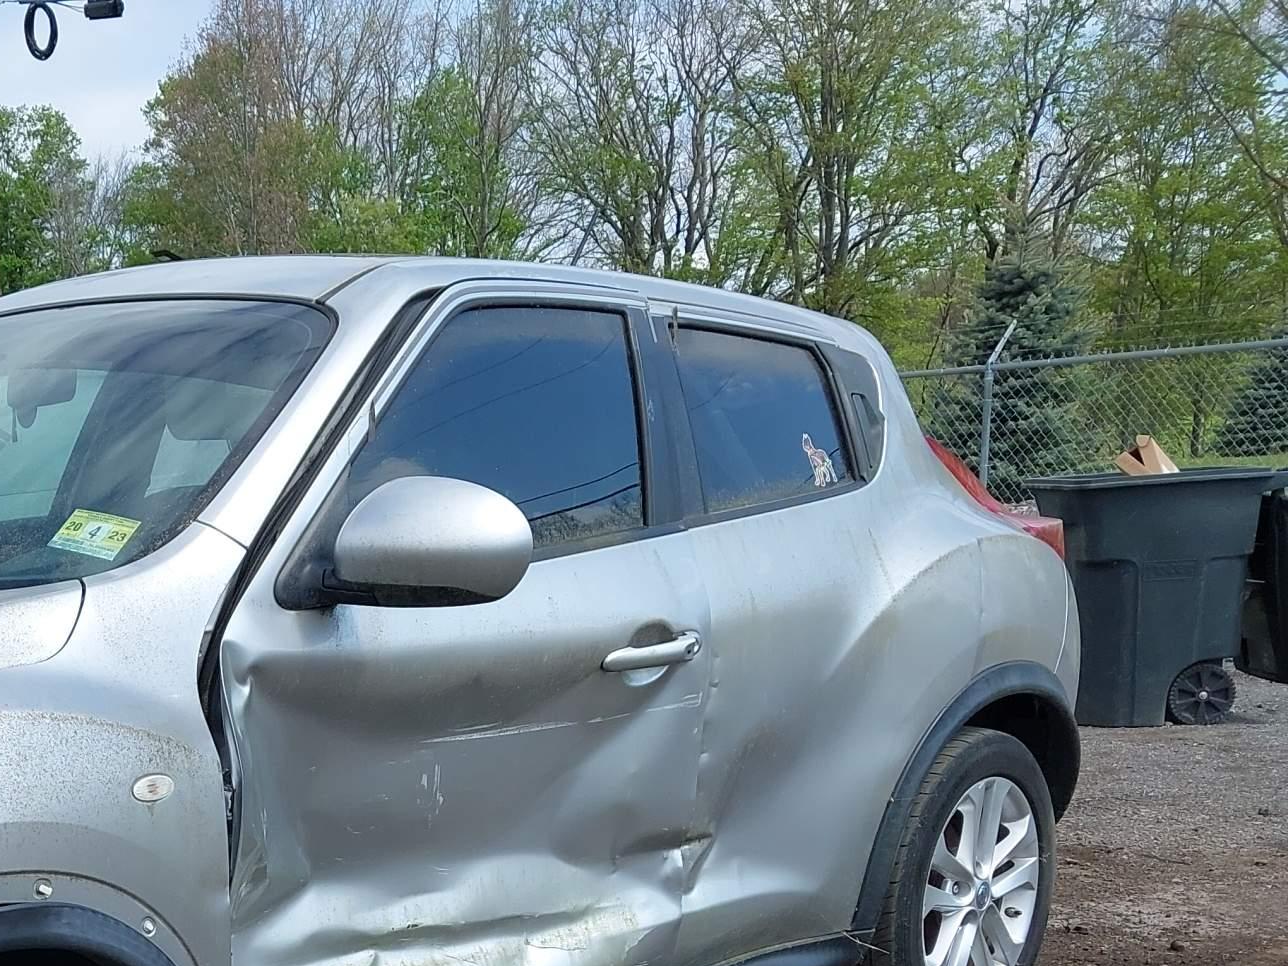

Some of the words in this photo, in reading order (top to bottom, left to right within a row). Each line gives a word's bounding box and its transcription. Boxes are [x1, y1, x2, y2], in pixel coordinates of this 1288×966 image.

[65, 521, 83, 532] 20
[88, 526, 102, 539] 4
[108, 530, 127, 541] 23
